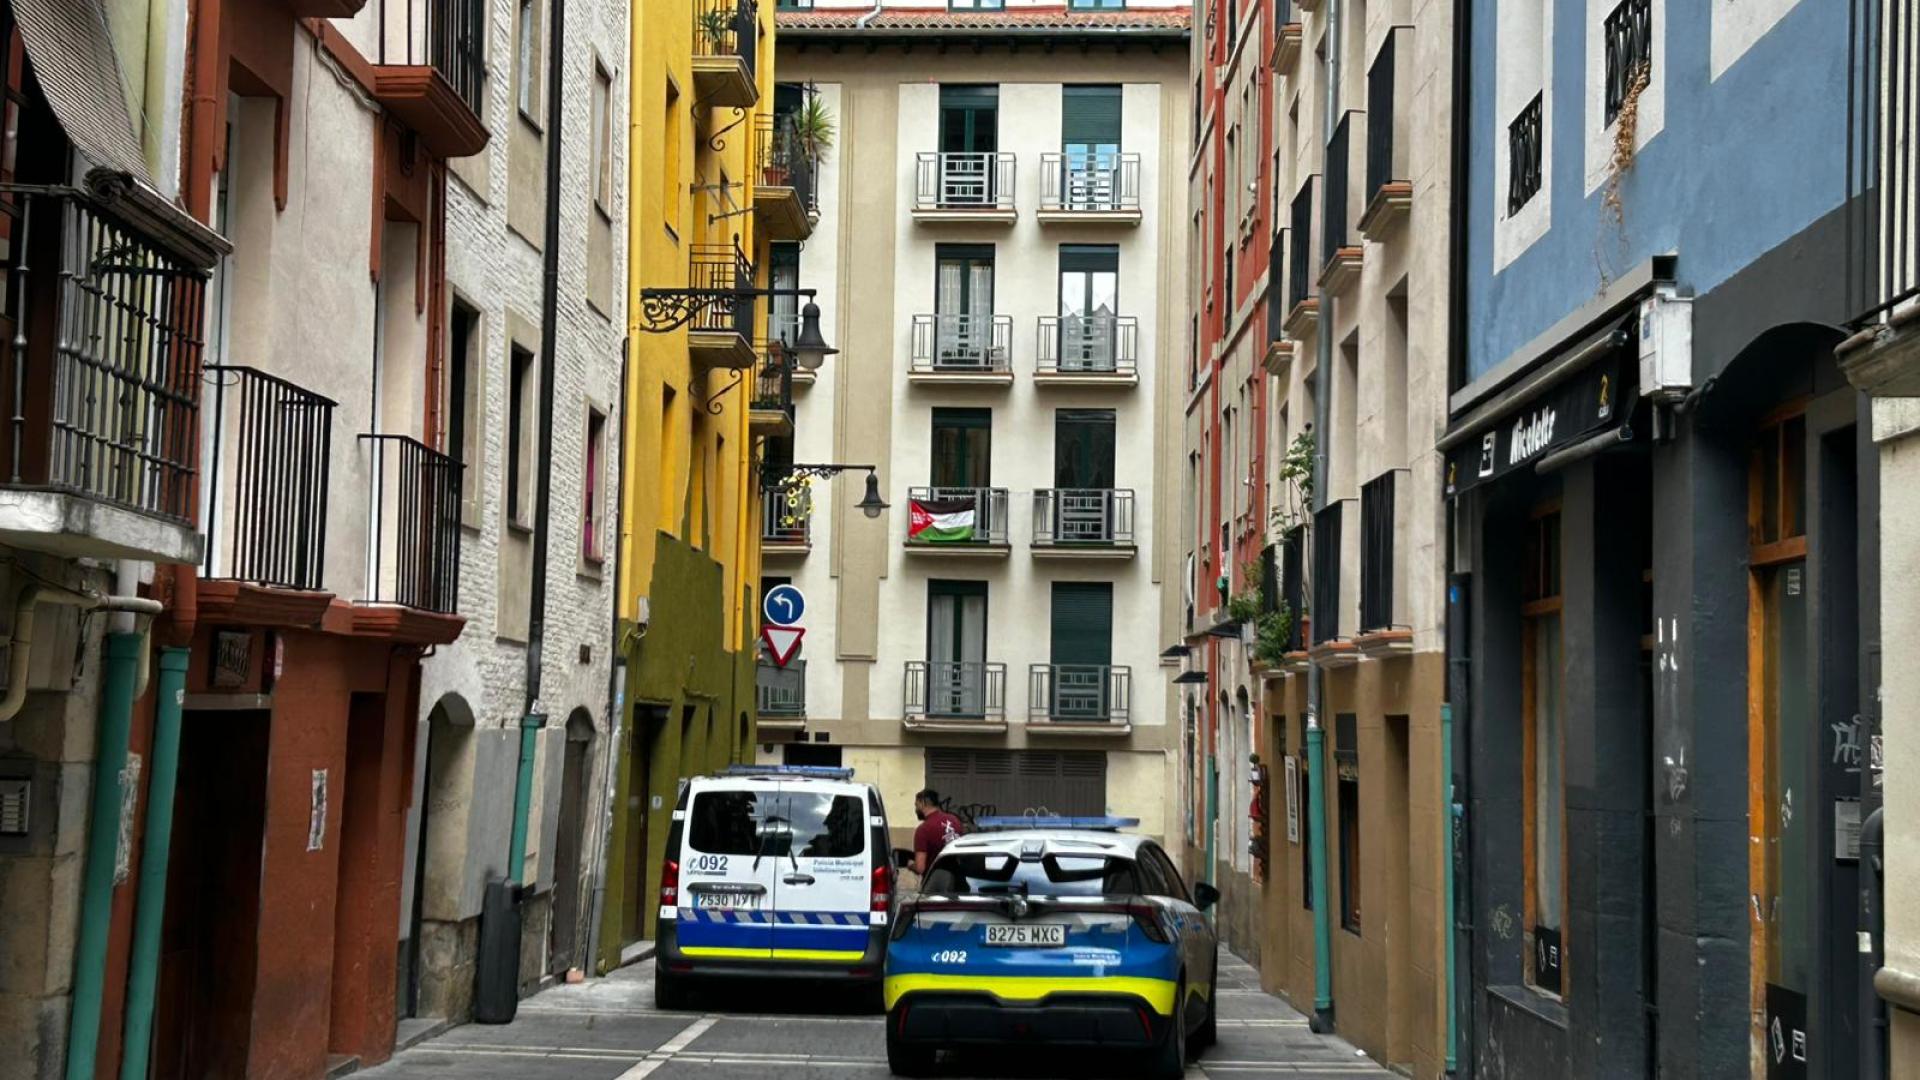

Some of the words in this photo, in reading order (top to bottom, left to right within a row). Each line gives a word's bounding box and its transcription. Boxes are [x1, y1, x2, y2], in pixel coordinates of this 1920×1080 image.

[699, 855, 728, 871] 092
[700, 893, 728, 906] 7530
[988, 927, 1026, 942] 8275
[1031, 927, 1060, 942] MXC
[941, 951, 967, 963] 092
